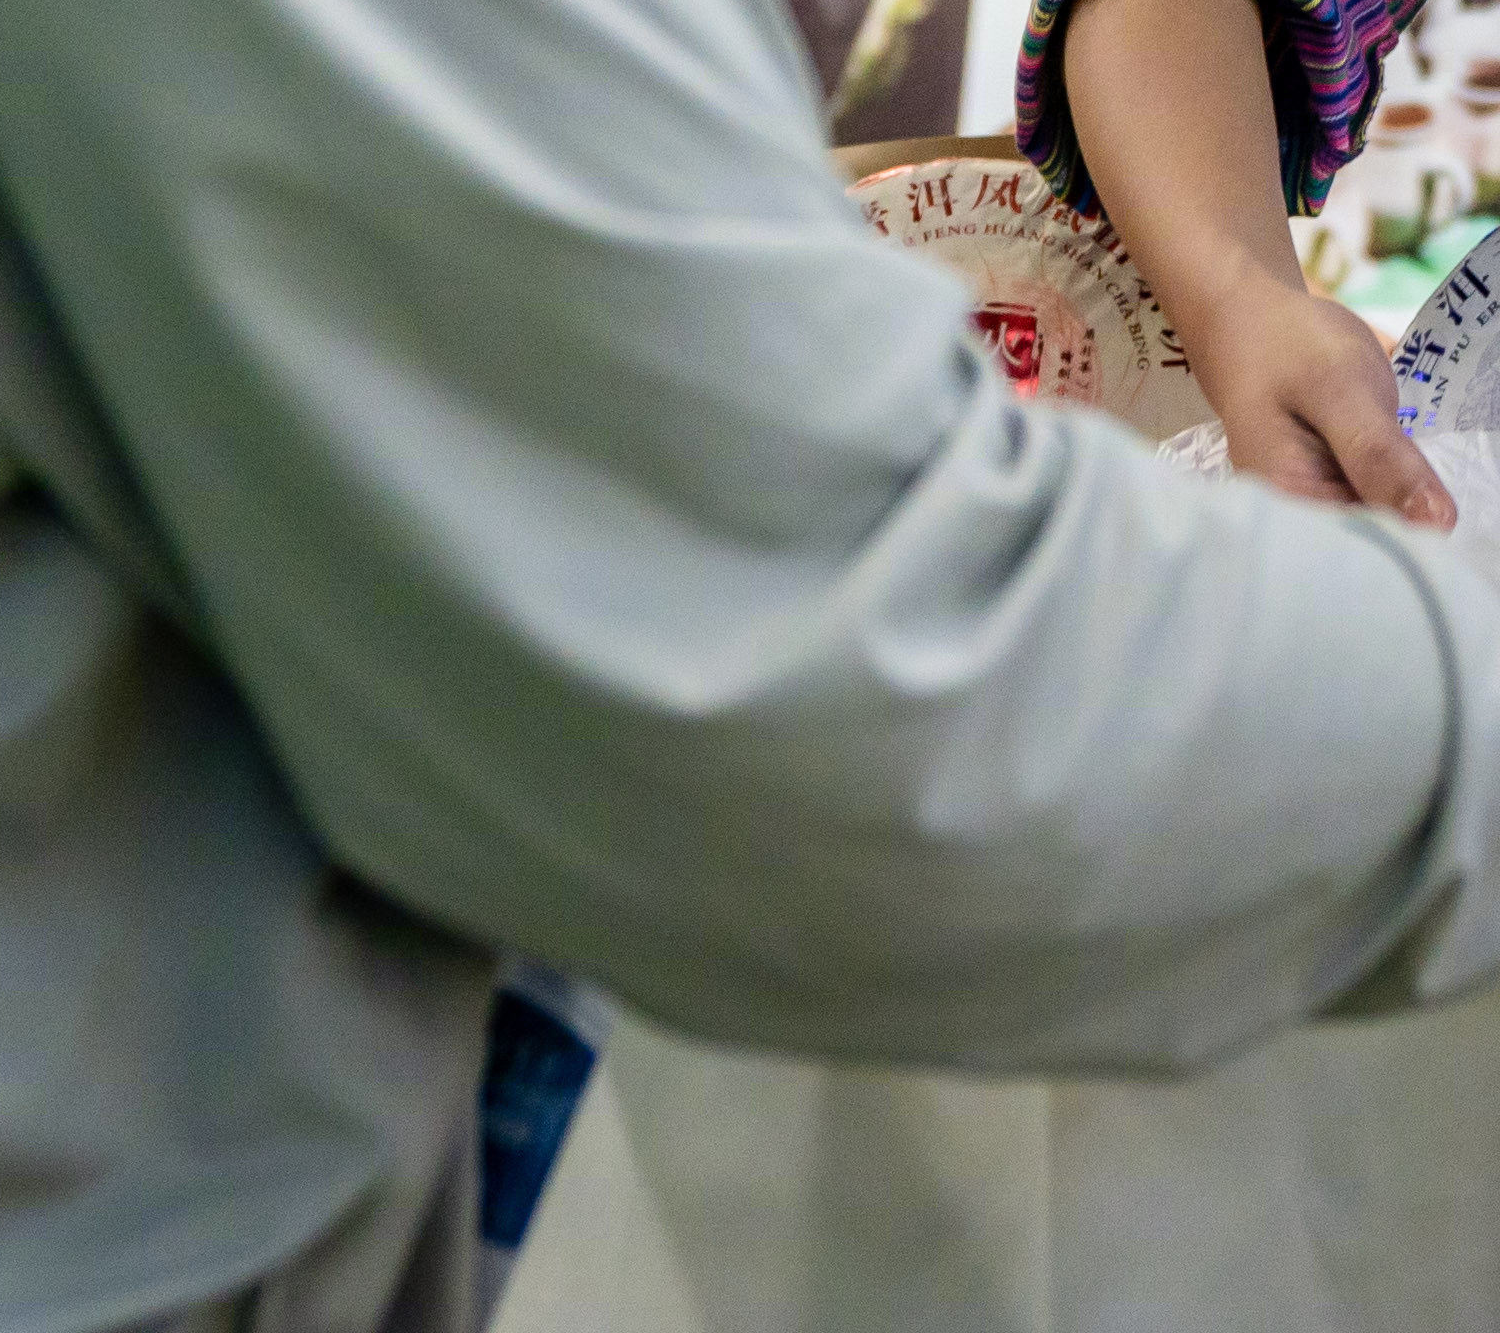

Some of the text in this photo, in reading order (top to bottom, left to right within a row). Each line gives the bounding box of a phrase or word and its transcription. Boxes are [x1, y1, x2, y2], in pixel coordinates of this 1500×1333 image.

[921, 221, 977, 243] FENG
[984, 220, 1057, 247] HUANG
[1105, 282, 1135, 321] CHA
[1127, 320, 1151, 371] BING
[1448, 332, 1471, 365] PU
